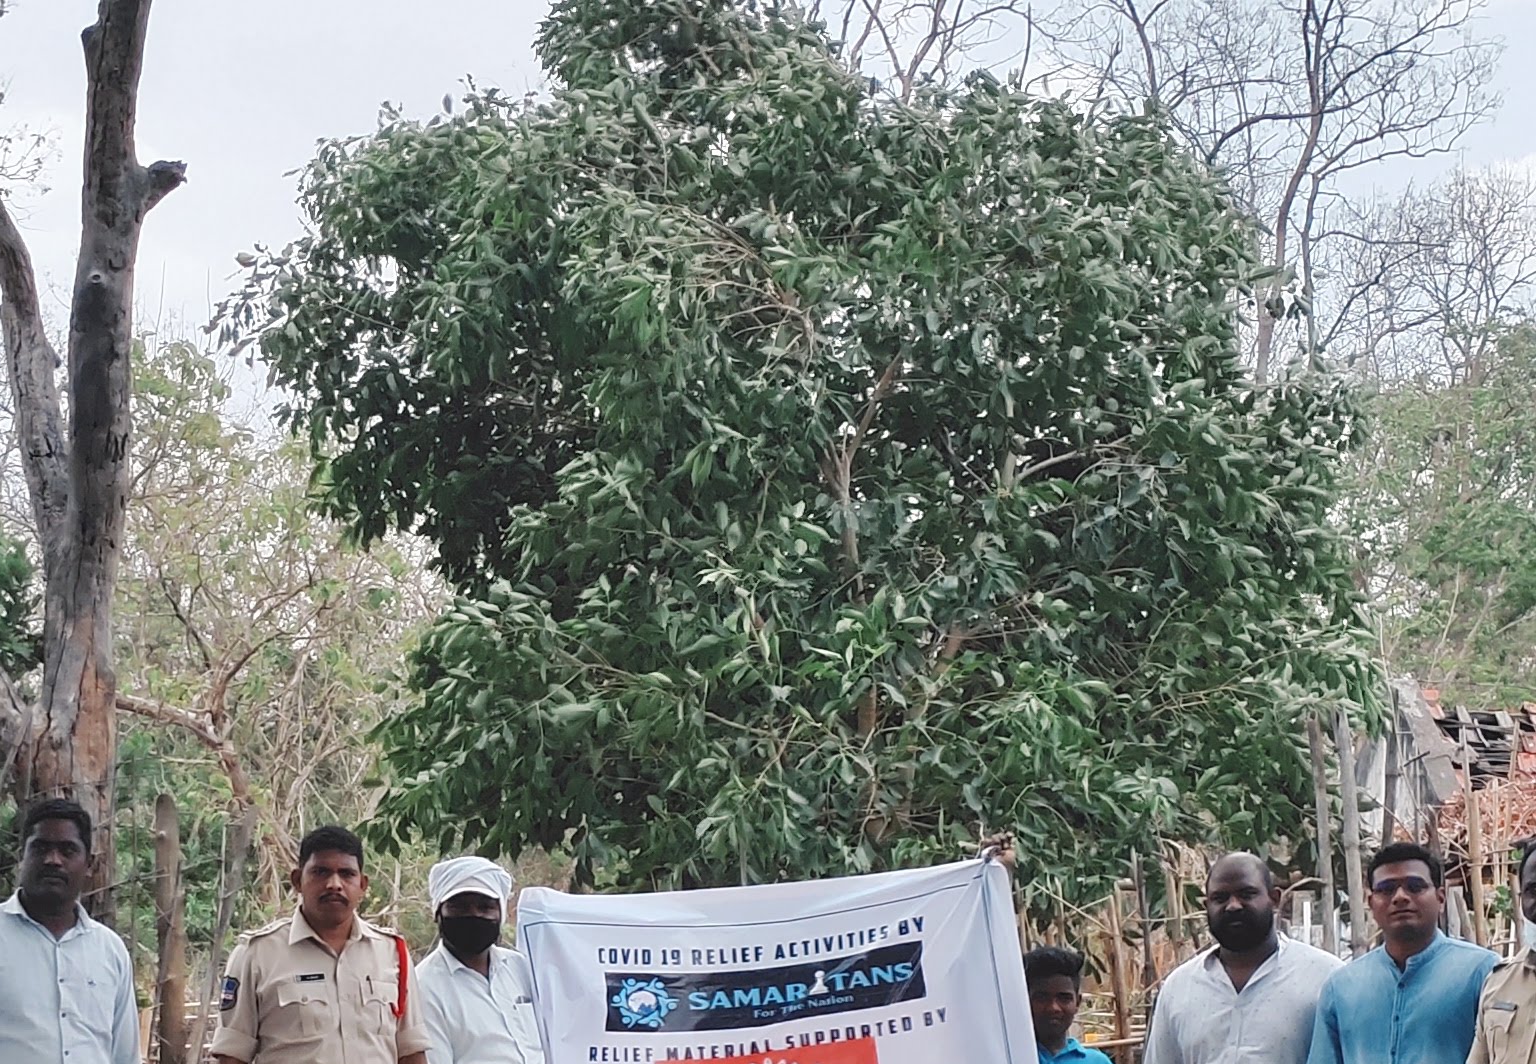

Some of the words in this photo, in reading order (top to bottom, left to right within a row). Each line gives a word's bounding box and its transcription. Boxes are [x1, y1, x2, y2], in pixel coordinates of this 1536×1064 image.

[598, 947, 651, 965] COVID
[661, 948, 681, 965] 19
[692, 946, 763, 965] RELIEF
[775, 925, 888, 960] ACTIVITIES
[898, 916, 924, 935] BY
[753, 1007, 776, 1019] For
[781, 1001, 803, 1017] The
[809, 993, 854, 1008] Nation
[589, 1046, 654, 1062] RELIEF
[667, 1039, 771, 1061] MATERIAL
[786, 1016, 912, 1049] SUPPORTED
[923, 1007, 948, 1027] BY
